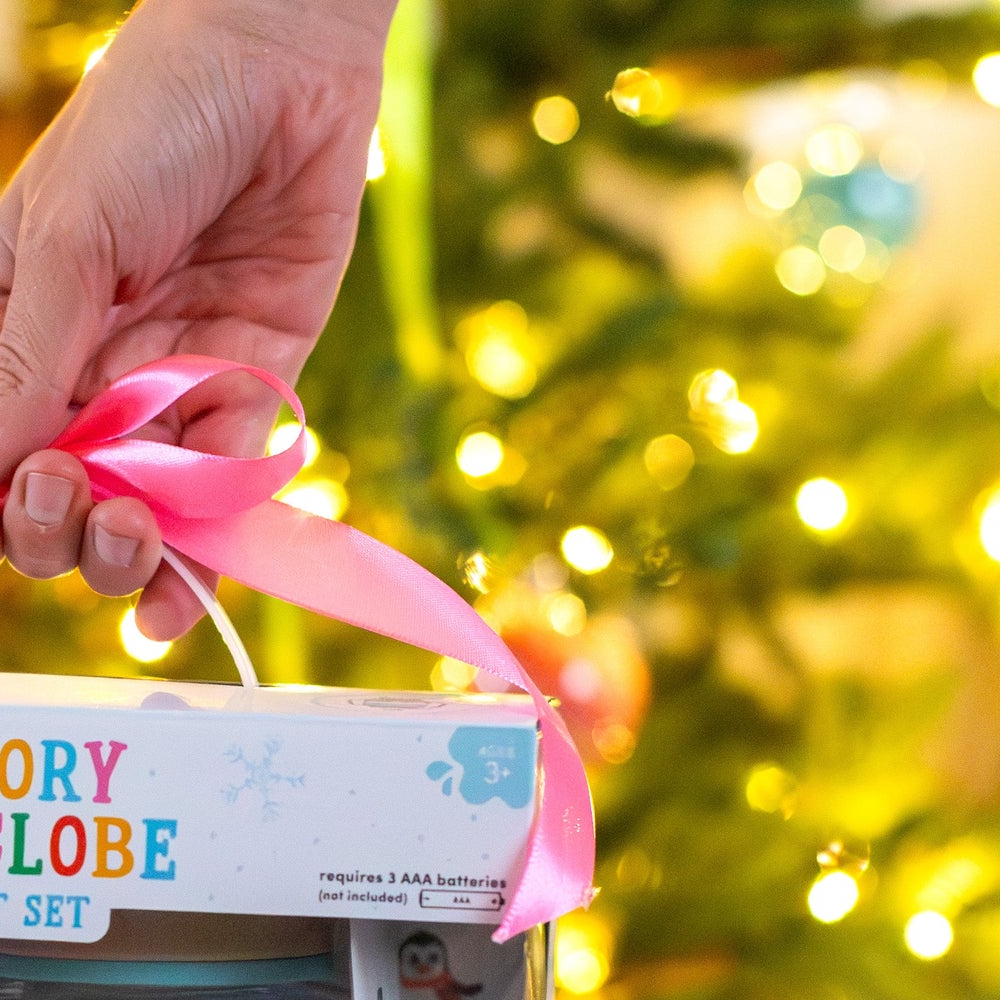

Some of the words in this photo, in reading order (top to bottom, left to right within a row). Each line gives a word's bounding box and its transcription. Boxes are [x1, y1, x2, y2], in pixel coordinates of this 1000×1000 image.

[483, 761, 512, 784] 3+
[319, 870, 383, 885] requires
[388, 872, 396, 883] 3
[401, 873, 432, 885] AAA
[437, 874, 507, 889] batteries
[318, 889, 343, 902] (not
[347, 889, 408, 905] included)
[23, 894, 91, 929] SET
